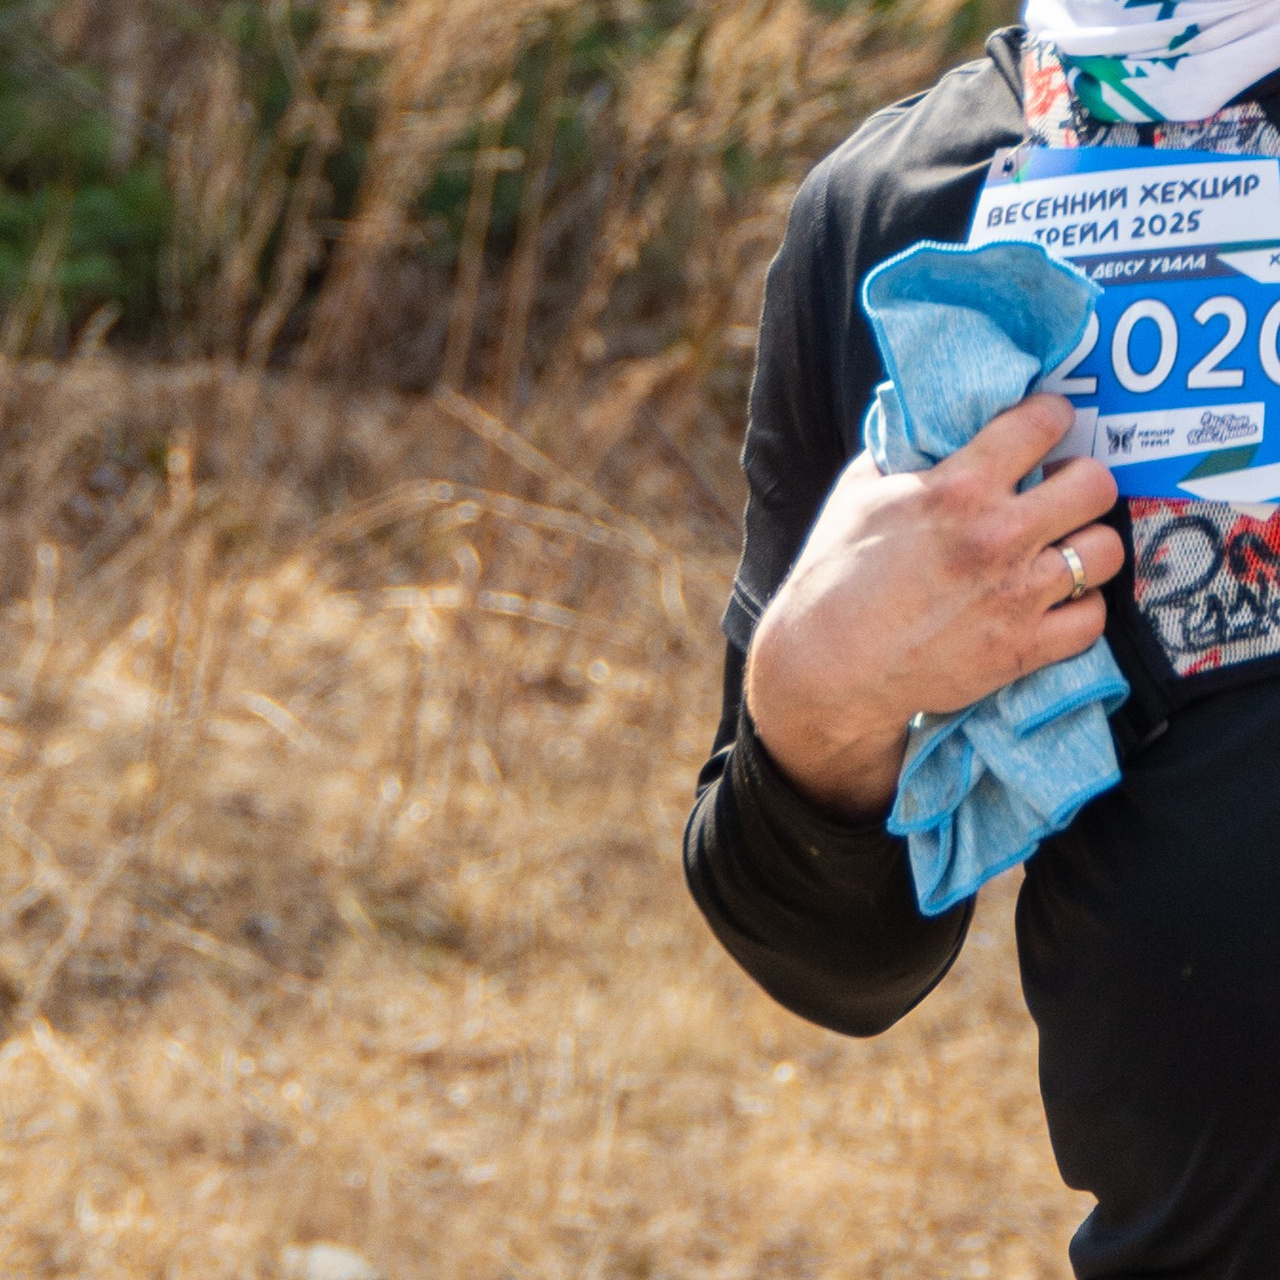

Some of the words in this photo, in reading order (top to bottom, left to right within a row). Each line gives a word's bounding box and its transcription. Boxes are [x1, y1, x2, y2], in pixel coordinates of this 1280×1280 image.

[986, 185, 1128, 228] ВЕСЕННИЙ
[1139, 174, 1260, 207] ХЕХЦИР
[1131, 209, 1203, 239] 2025
